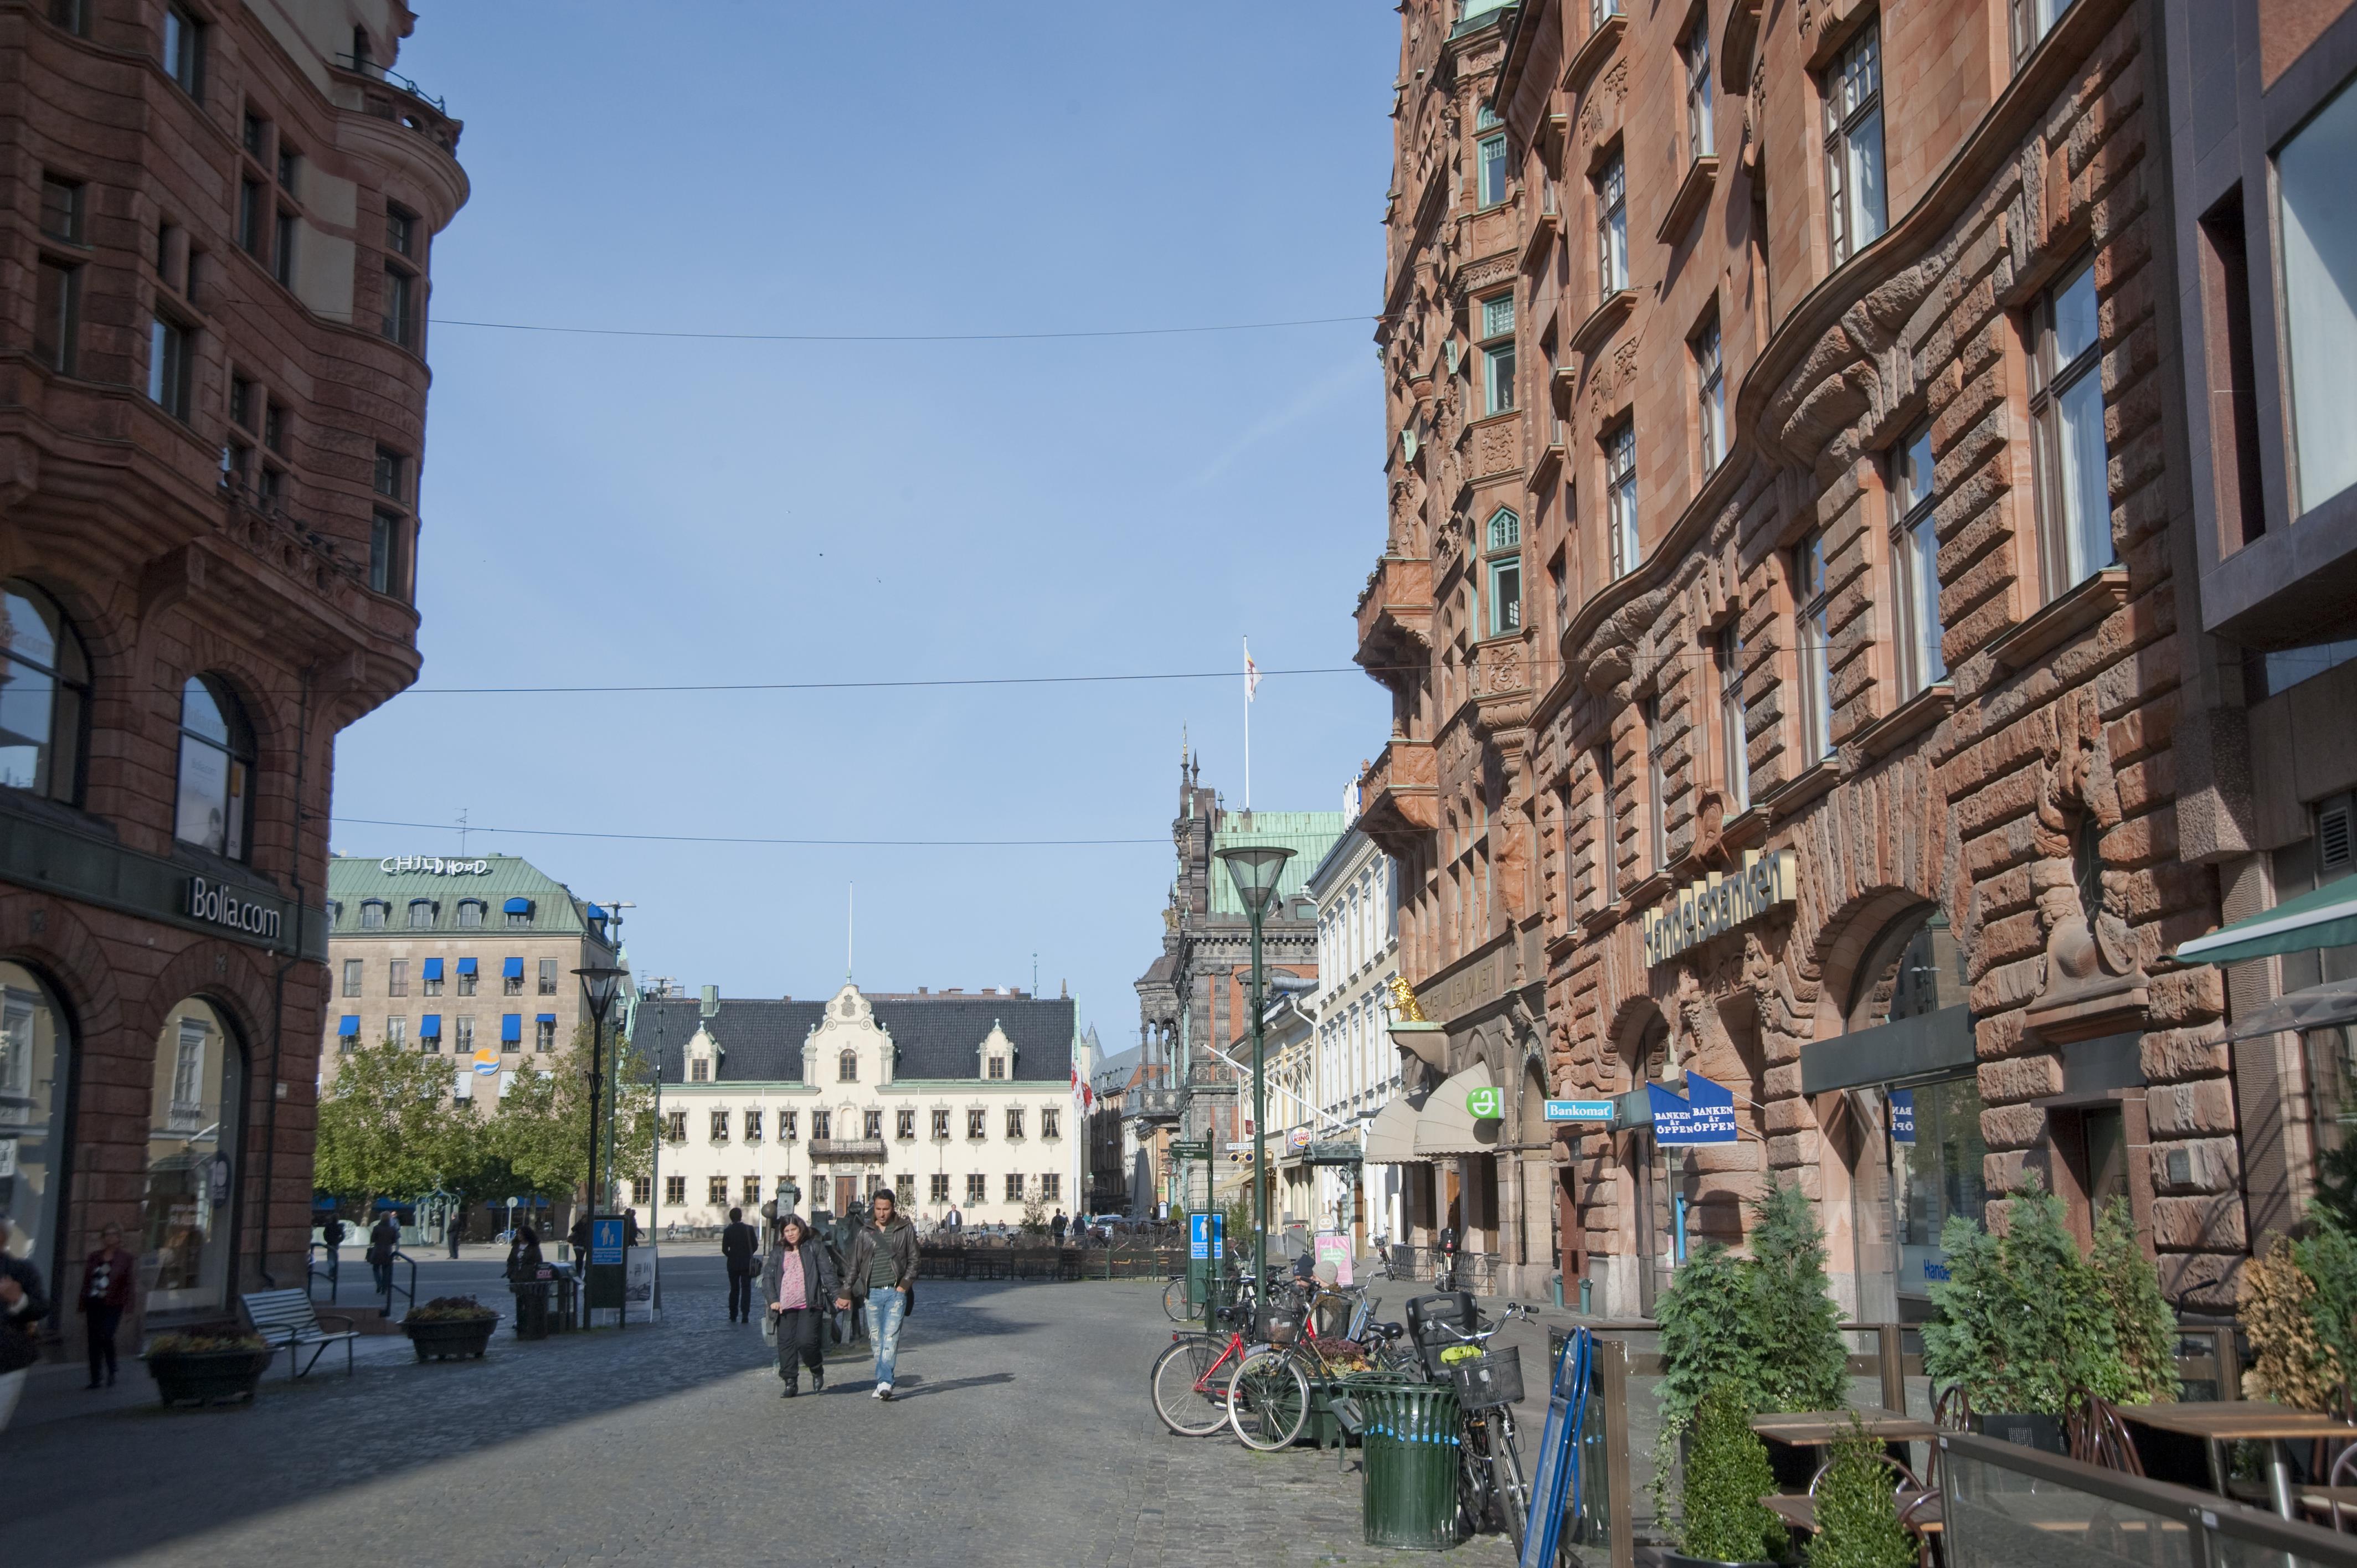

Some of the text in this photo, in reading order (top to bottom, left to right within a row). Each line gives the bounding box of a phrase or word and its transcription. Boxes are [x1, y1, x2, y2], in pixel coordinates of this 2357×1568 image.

[193, 876, 280, 938] Bolia.com
[1643, 849, 1796, 968] Handelsbanken
[1654, 1112, 1691, 1120] BANKEN
[1692, 1106, 1733, 1116] BANKEN
[1694, 1122, 1735, 1132] ÖPPEN
